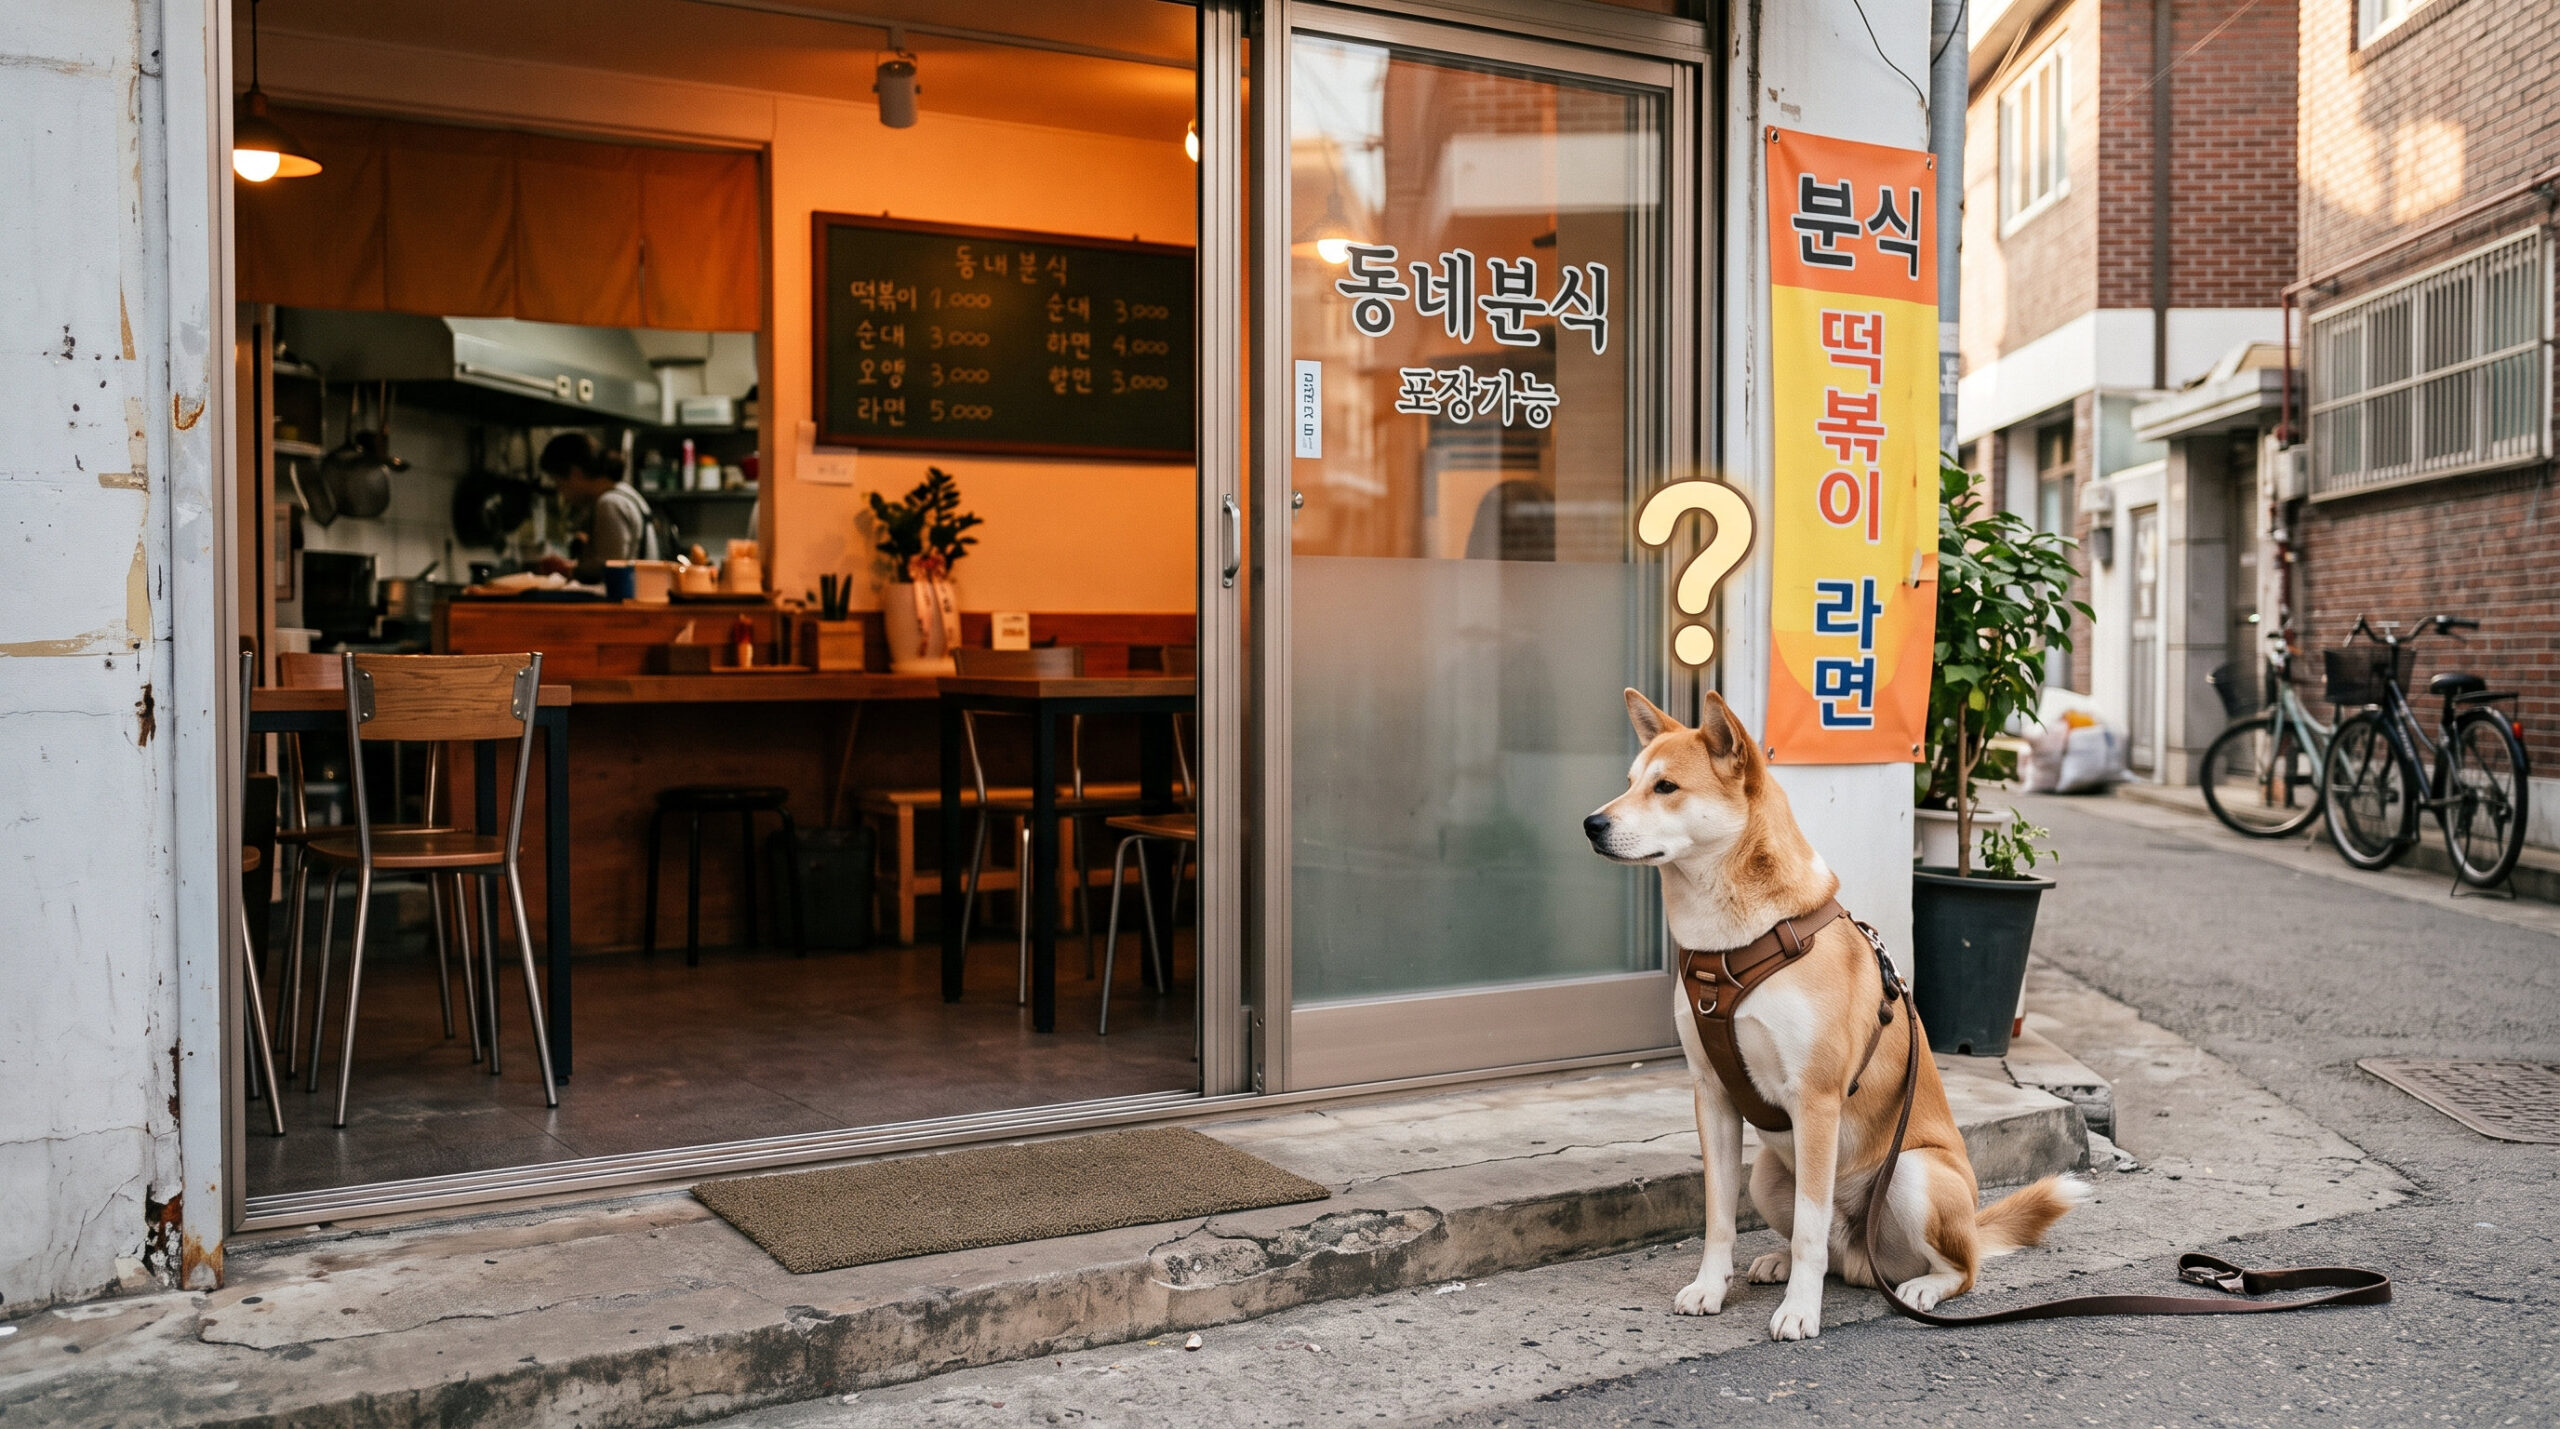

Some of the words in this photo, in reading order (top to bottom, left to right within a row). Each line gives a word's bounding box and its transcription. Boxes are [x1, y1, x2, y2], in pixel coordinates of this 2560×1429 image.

[1790, 172, 1922, 281] 분식
[850, 278, 917, 313] 떡볶이
[855, 319, 905, 351] 순대
[1335, 244, 1609, 355] 동네분식
[857, 395, 906, 427] 라면
[1395, 365, 1560, 429] 포장가능
[1815, 308, 1888, 545] 떡볶이
[1812, 575, 1884, 731] 라면
